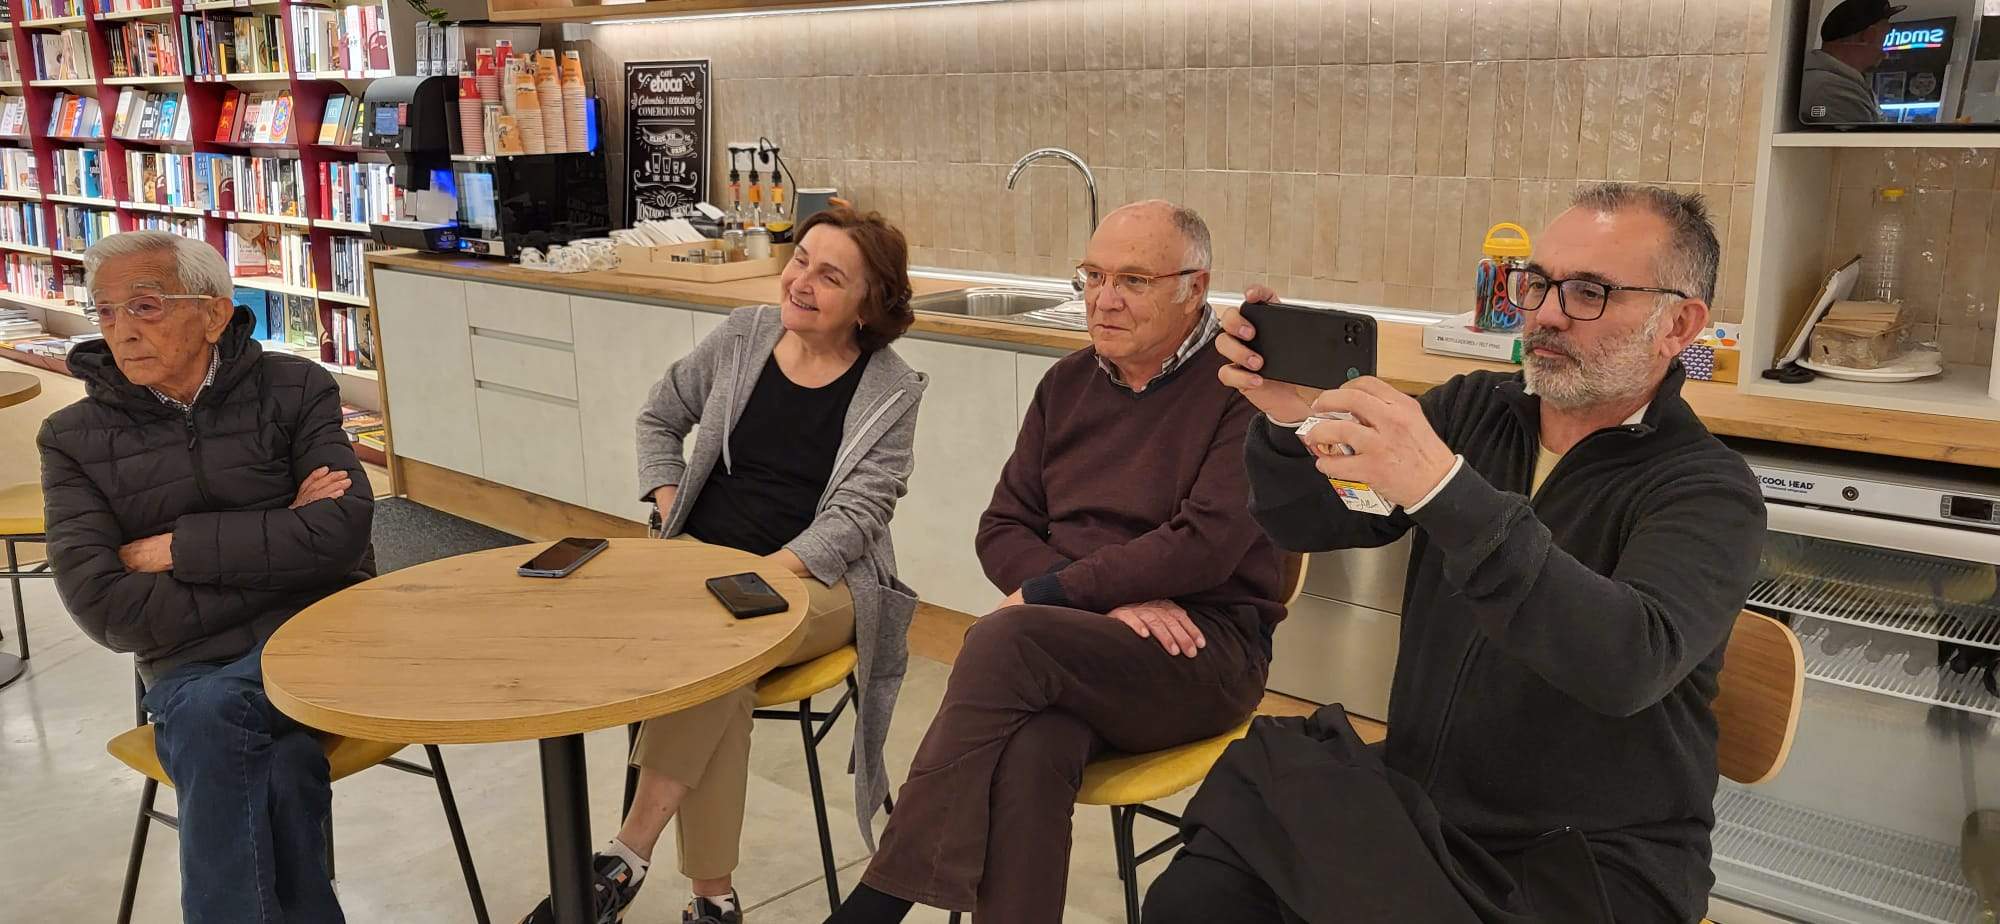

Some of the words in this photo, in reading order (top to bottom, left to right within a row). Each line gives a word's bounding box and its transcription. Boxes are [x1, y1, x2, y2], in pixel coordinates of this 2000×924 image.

[650, 75, 683, 93] eboca
[638, 107, 673, 117] COMERCIO
[673, 106, 696, 117] JUSTO
[635, 198, 665, 221] TOSTADO
[1762, 477, 1786, 486] COOL
[1789, 480, 1813, 490] HEAD
